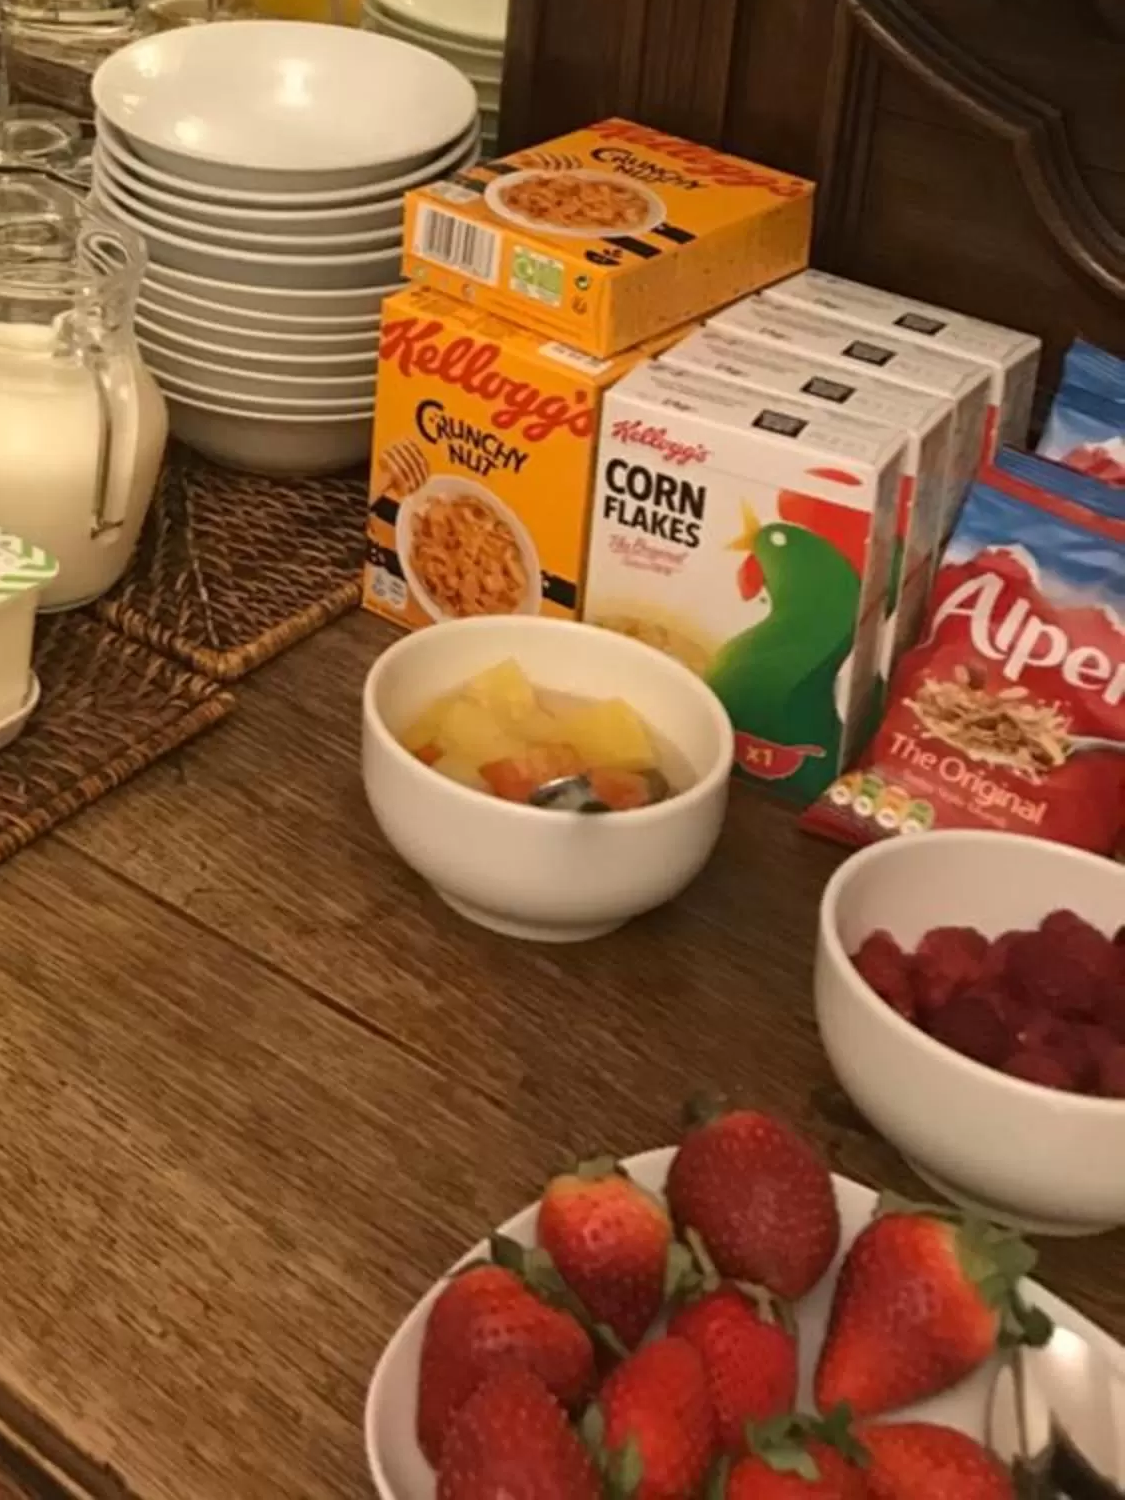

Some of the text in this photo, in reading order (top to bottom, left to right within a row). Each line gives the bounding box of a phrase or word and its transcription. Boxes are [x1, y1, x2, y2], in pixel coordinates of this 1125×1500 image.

[378, 318, 595, 442] Kellogg's
[415, 399, 529, 474] CRUNCHY
[447, 442, 497, 478] NUT
[611, 419, 712, 466] Kellogg's
[605, 457, 707, 521] CORN
[603, 494, 702, 549] FLAKES
[888, 731, 939, 771] The
[938, 756, 1048, 825] Original
